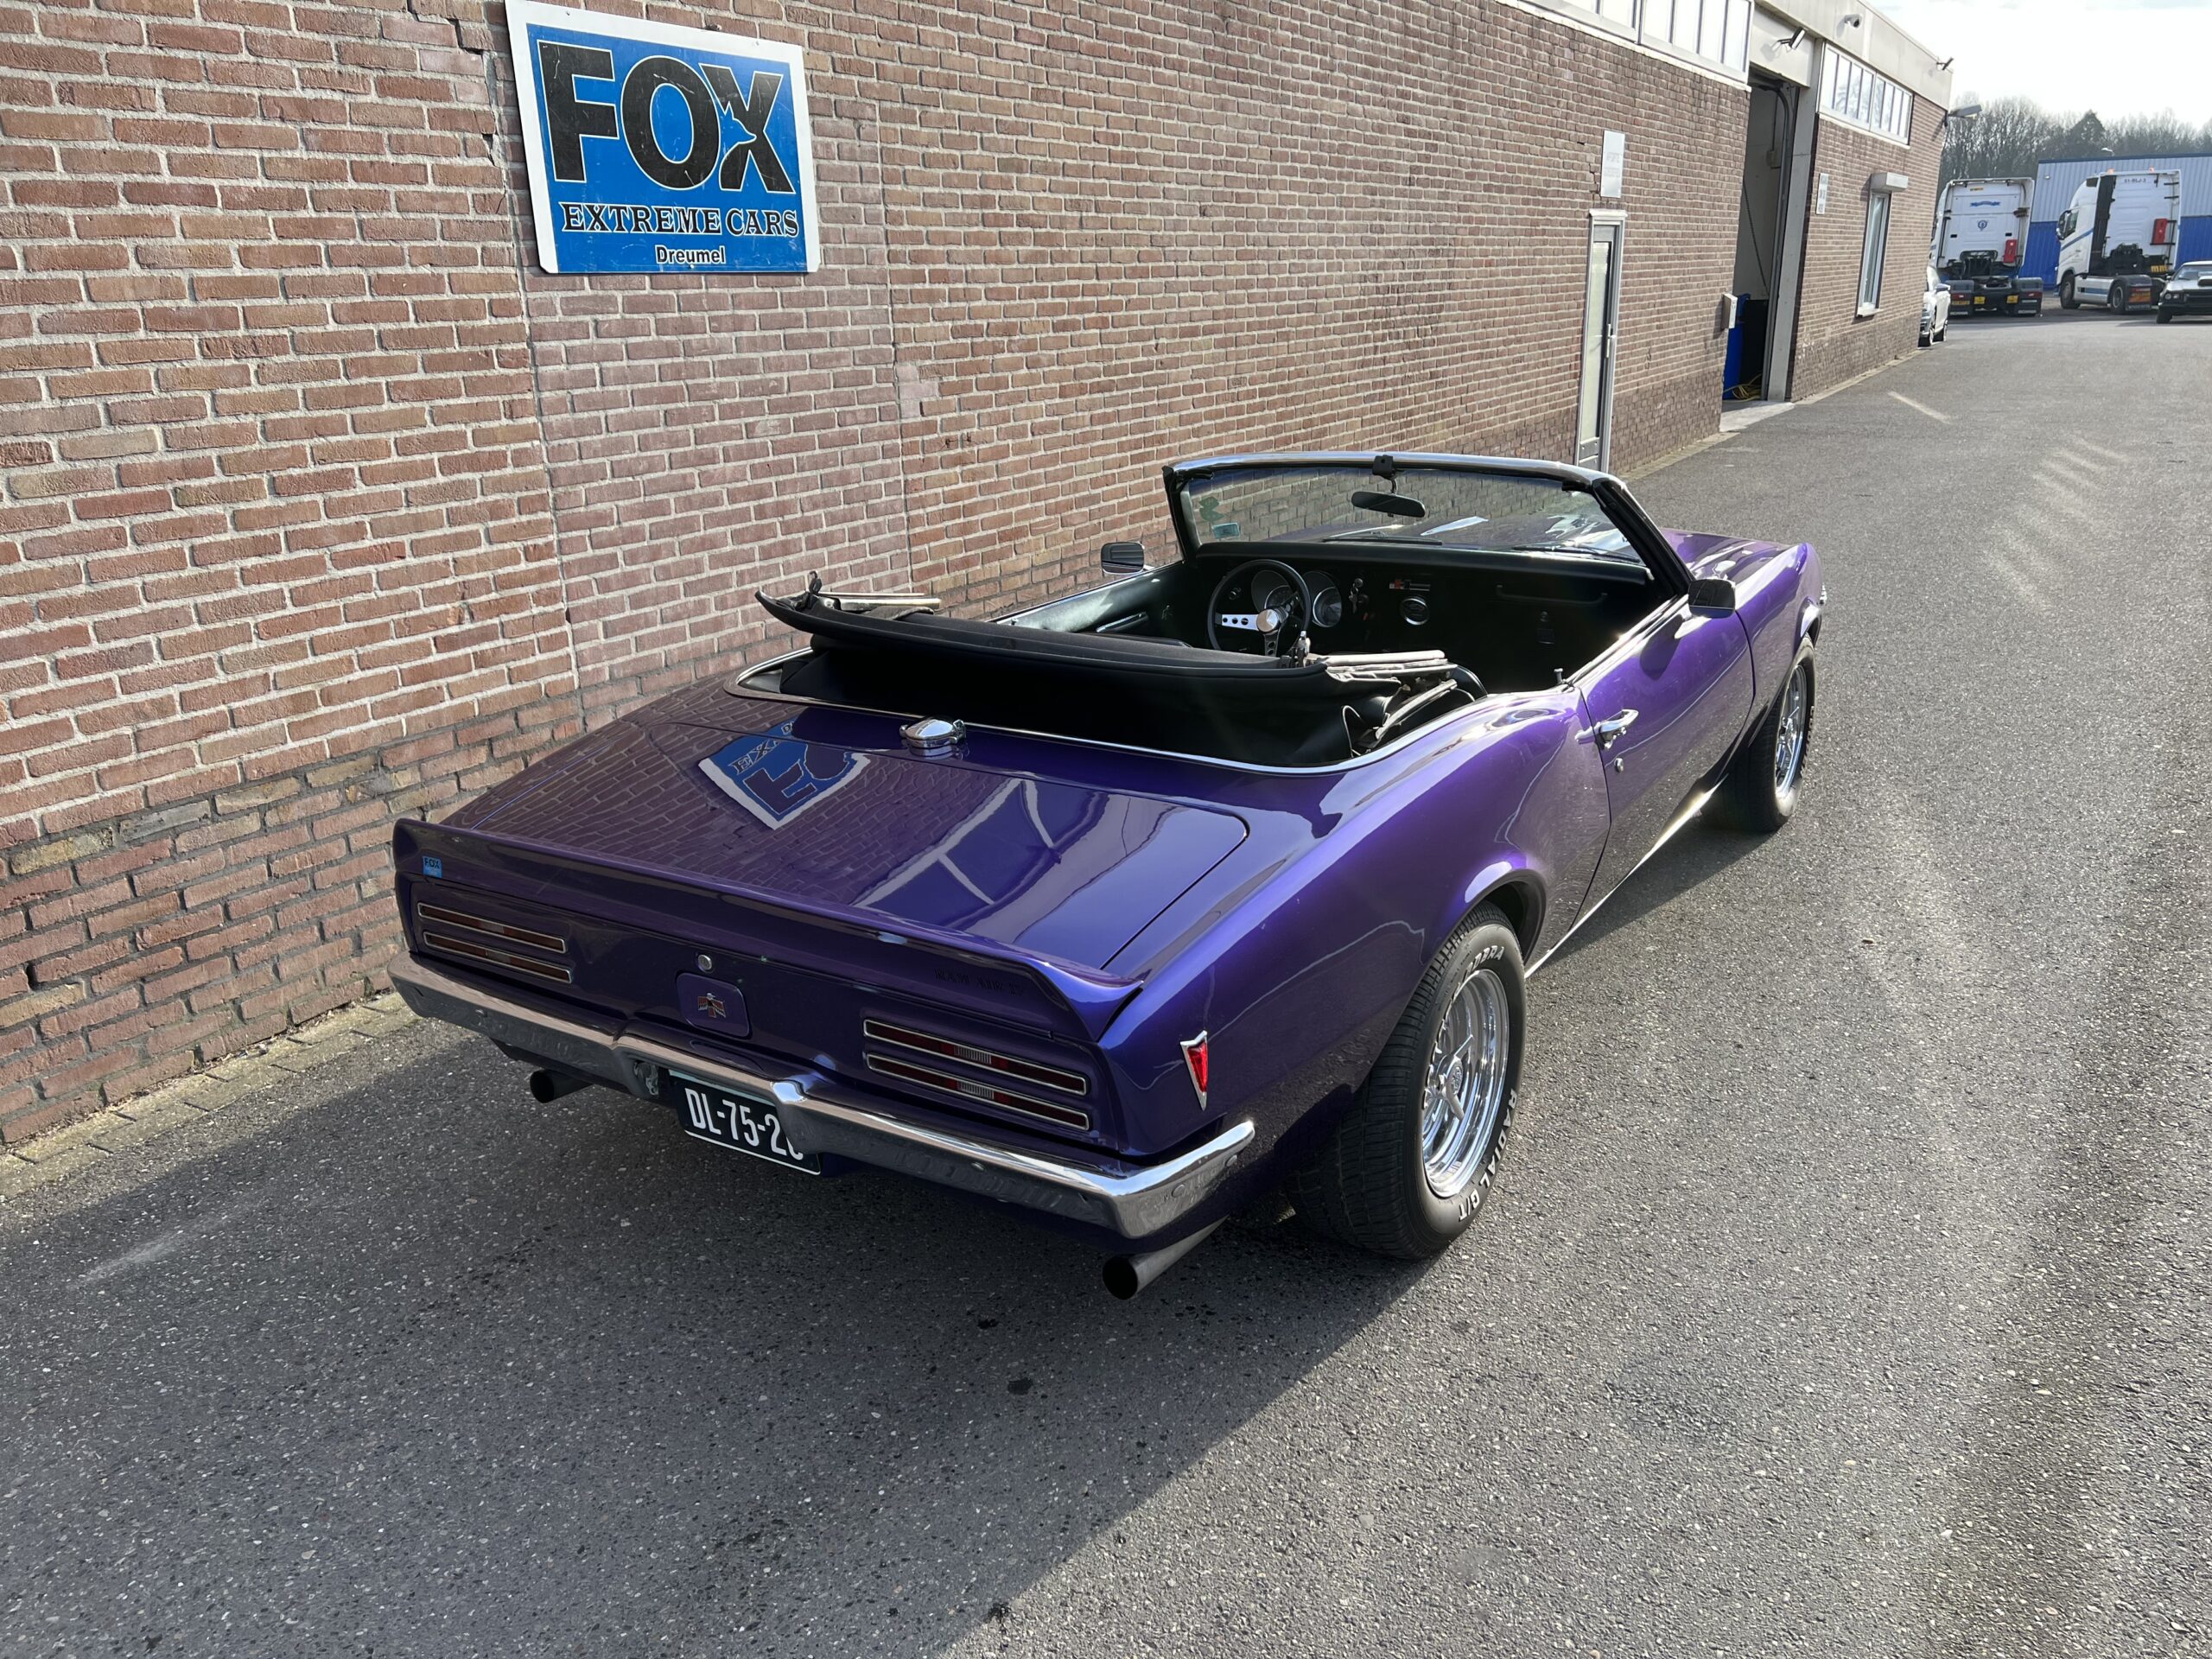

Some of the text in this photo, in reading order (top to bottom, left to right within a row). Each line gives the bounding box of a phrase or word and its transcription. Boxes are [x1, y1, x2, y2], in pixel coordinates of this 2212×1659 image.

[537, 39, 797, 194] FOX
[558, 201, 799, 238] EXTREME CARS
[655, 245, 726, 265] Dreumel
[424, 857, 440, 869] FOX
[1479, 1088, 1518, 1188] RADIAL
